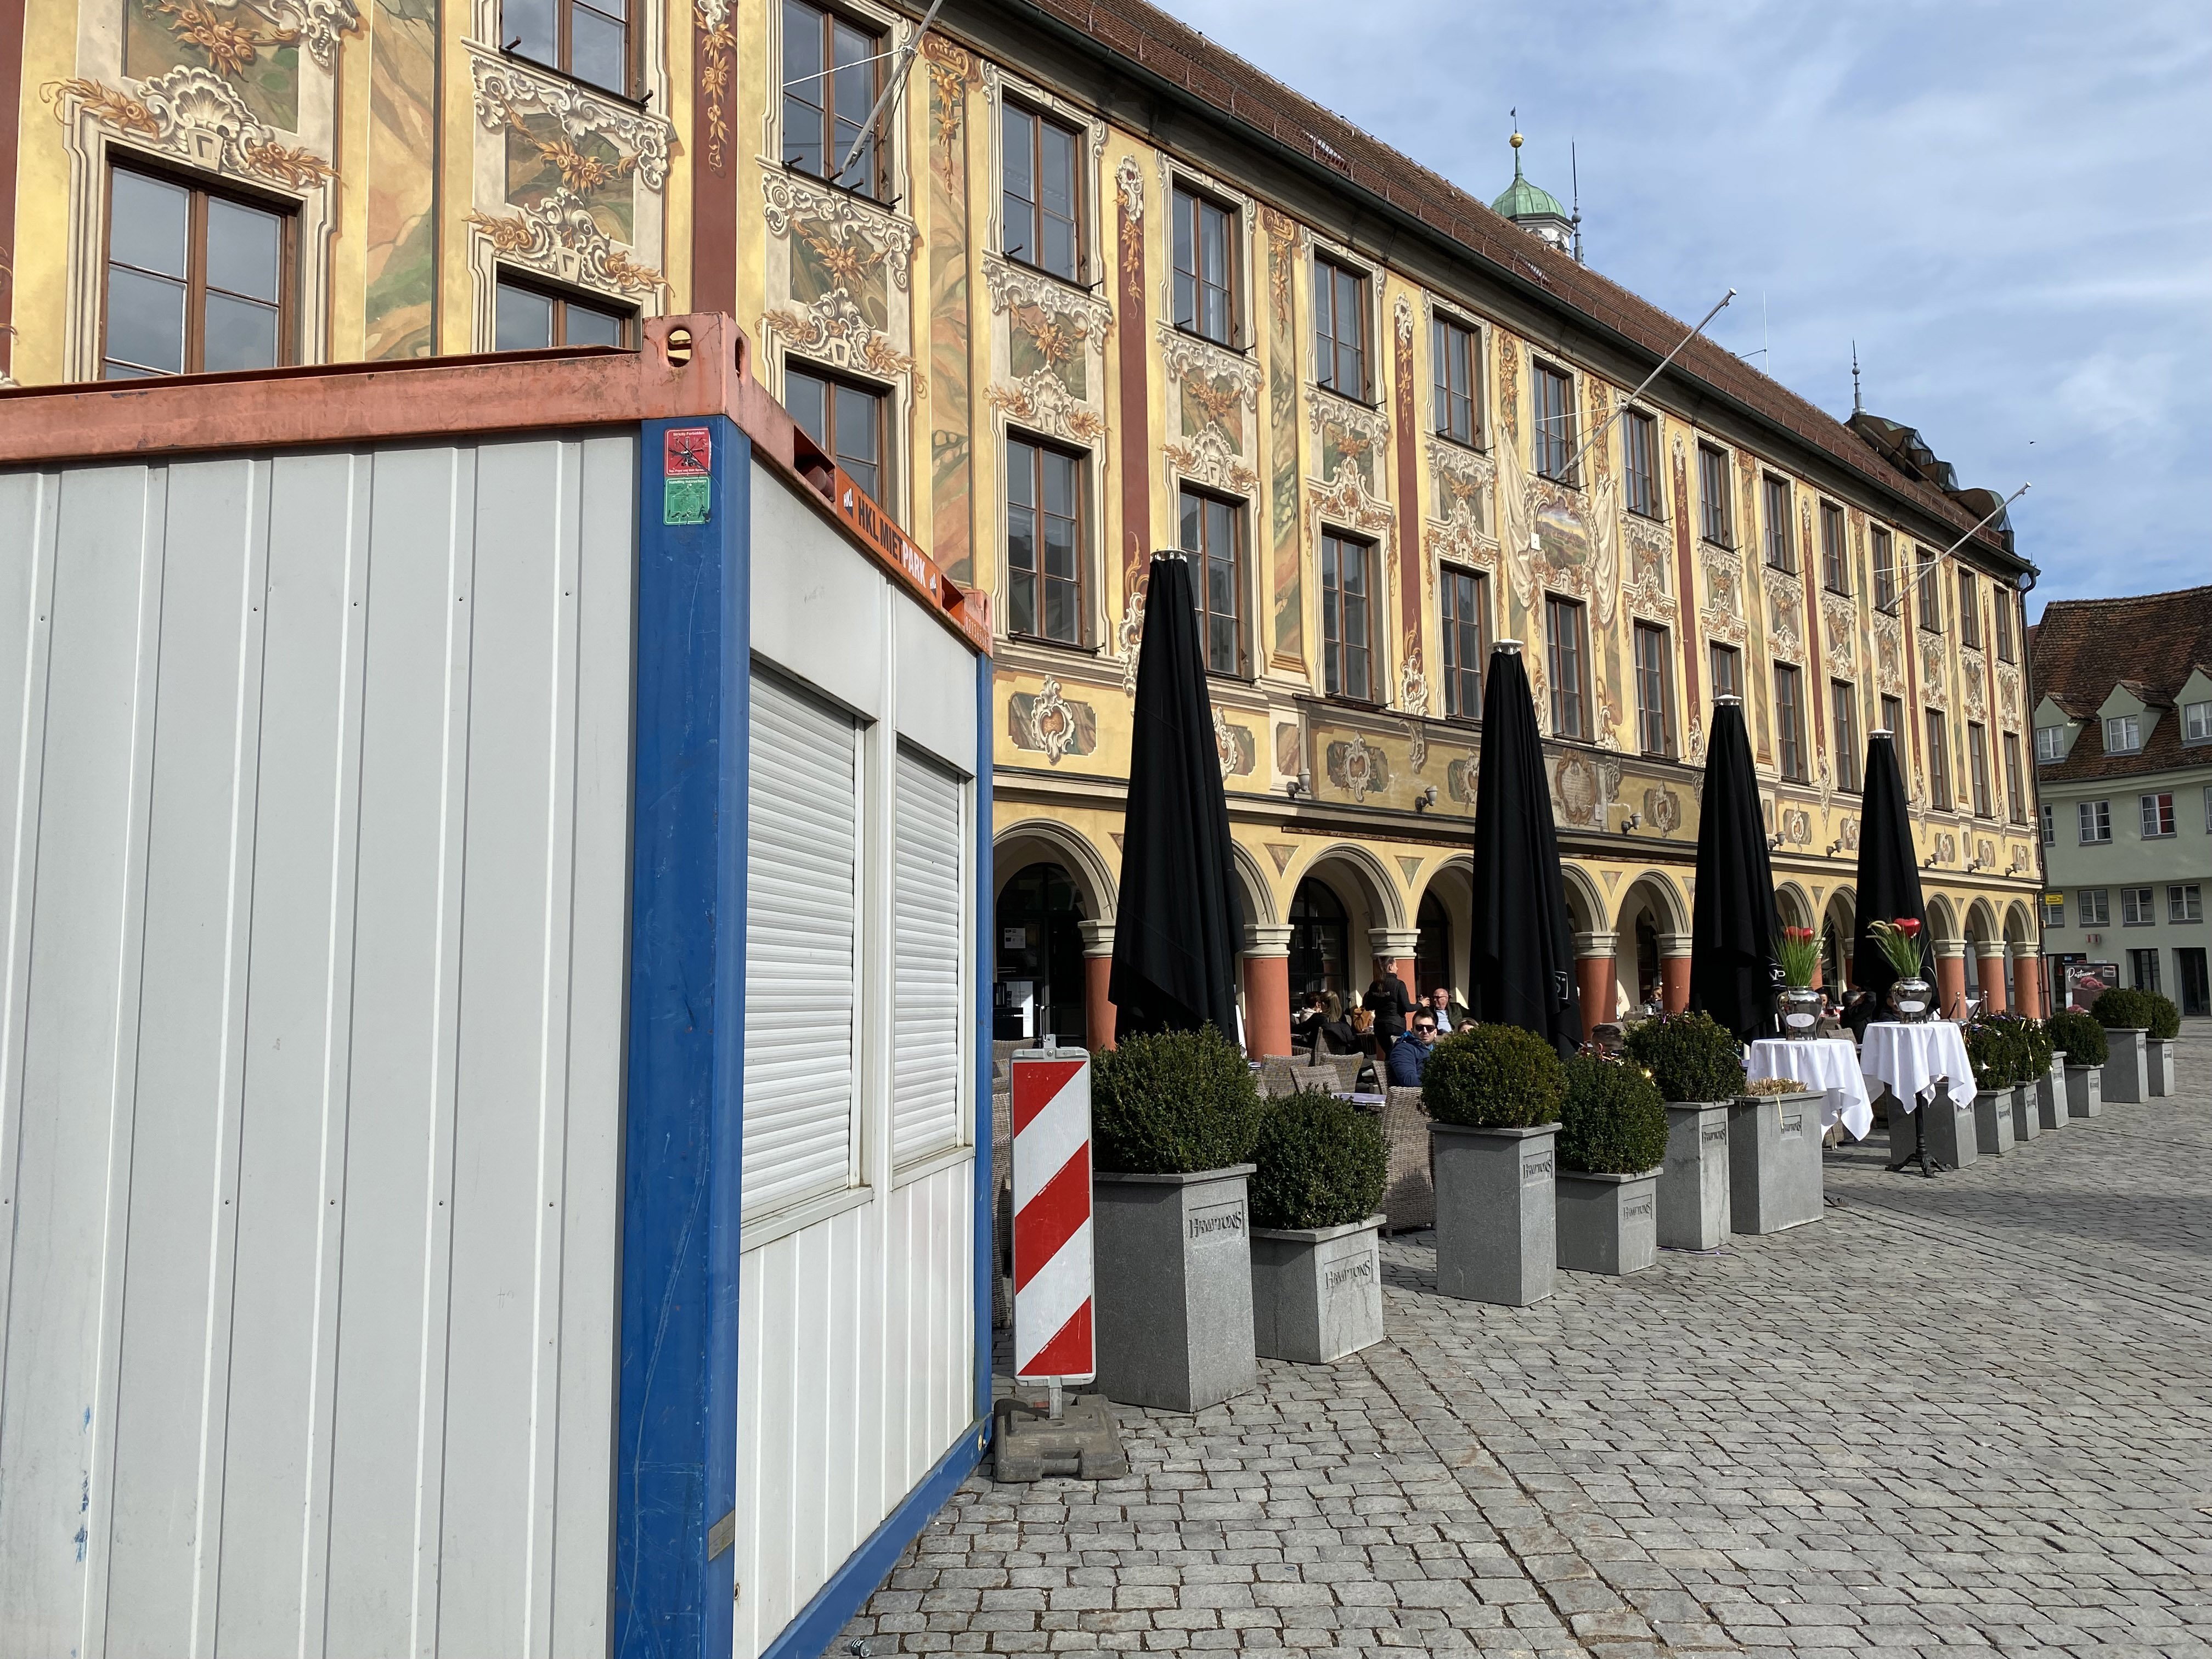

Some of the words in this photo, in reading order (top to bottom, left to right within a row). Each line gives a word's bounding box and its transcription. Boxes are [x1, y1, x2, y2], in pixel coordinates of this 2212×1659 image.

[858, 495, 879, 543] HKL
[1189, 1211, 1242, 1238] HAMPTONS
[1325, 1260, 1370, 1290] HAMPTONS
